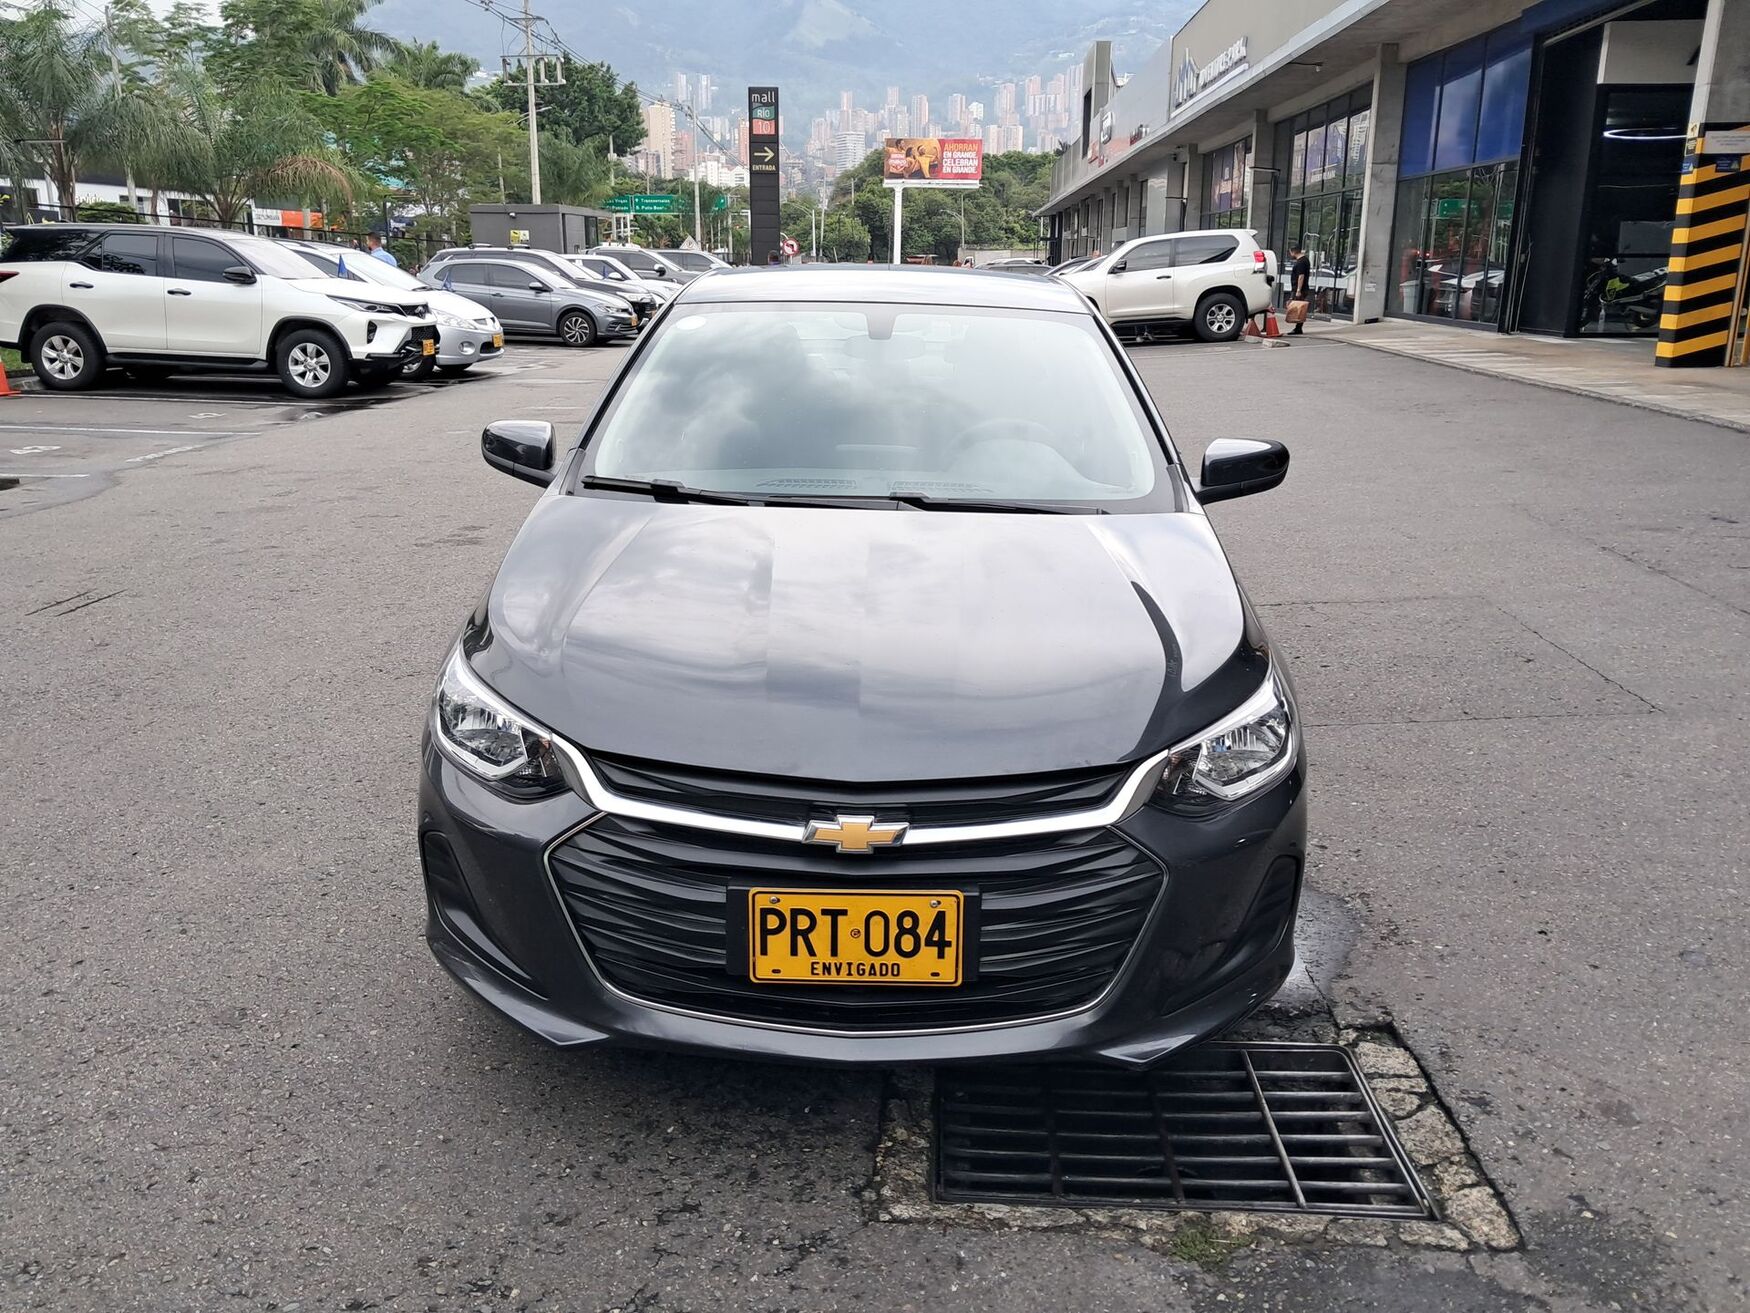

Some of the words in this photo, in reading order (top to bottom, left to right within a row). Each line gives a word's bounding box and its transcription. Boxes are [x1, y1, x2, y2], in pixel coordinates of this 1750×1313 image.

[751, 91, 775, 103] mall
[758, 121, 771, 134] 10
[944, 143, 978, 152] AHORRAN
[942, 158, 978, 167] CELEBRAN
[943, 166, 952, 174] EN
[759, 907, 848, 958] PRT
[864, 909, 952, 960] 084
[810, 961, 900, 977] ENVIGADO
